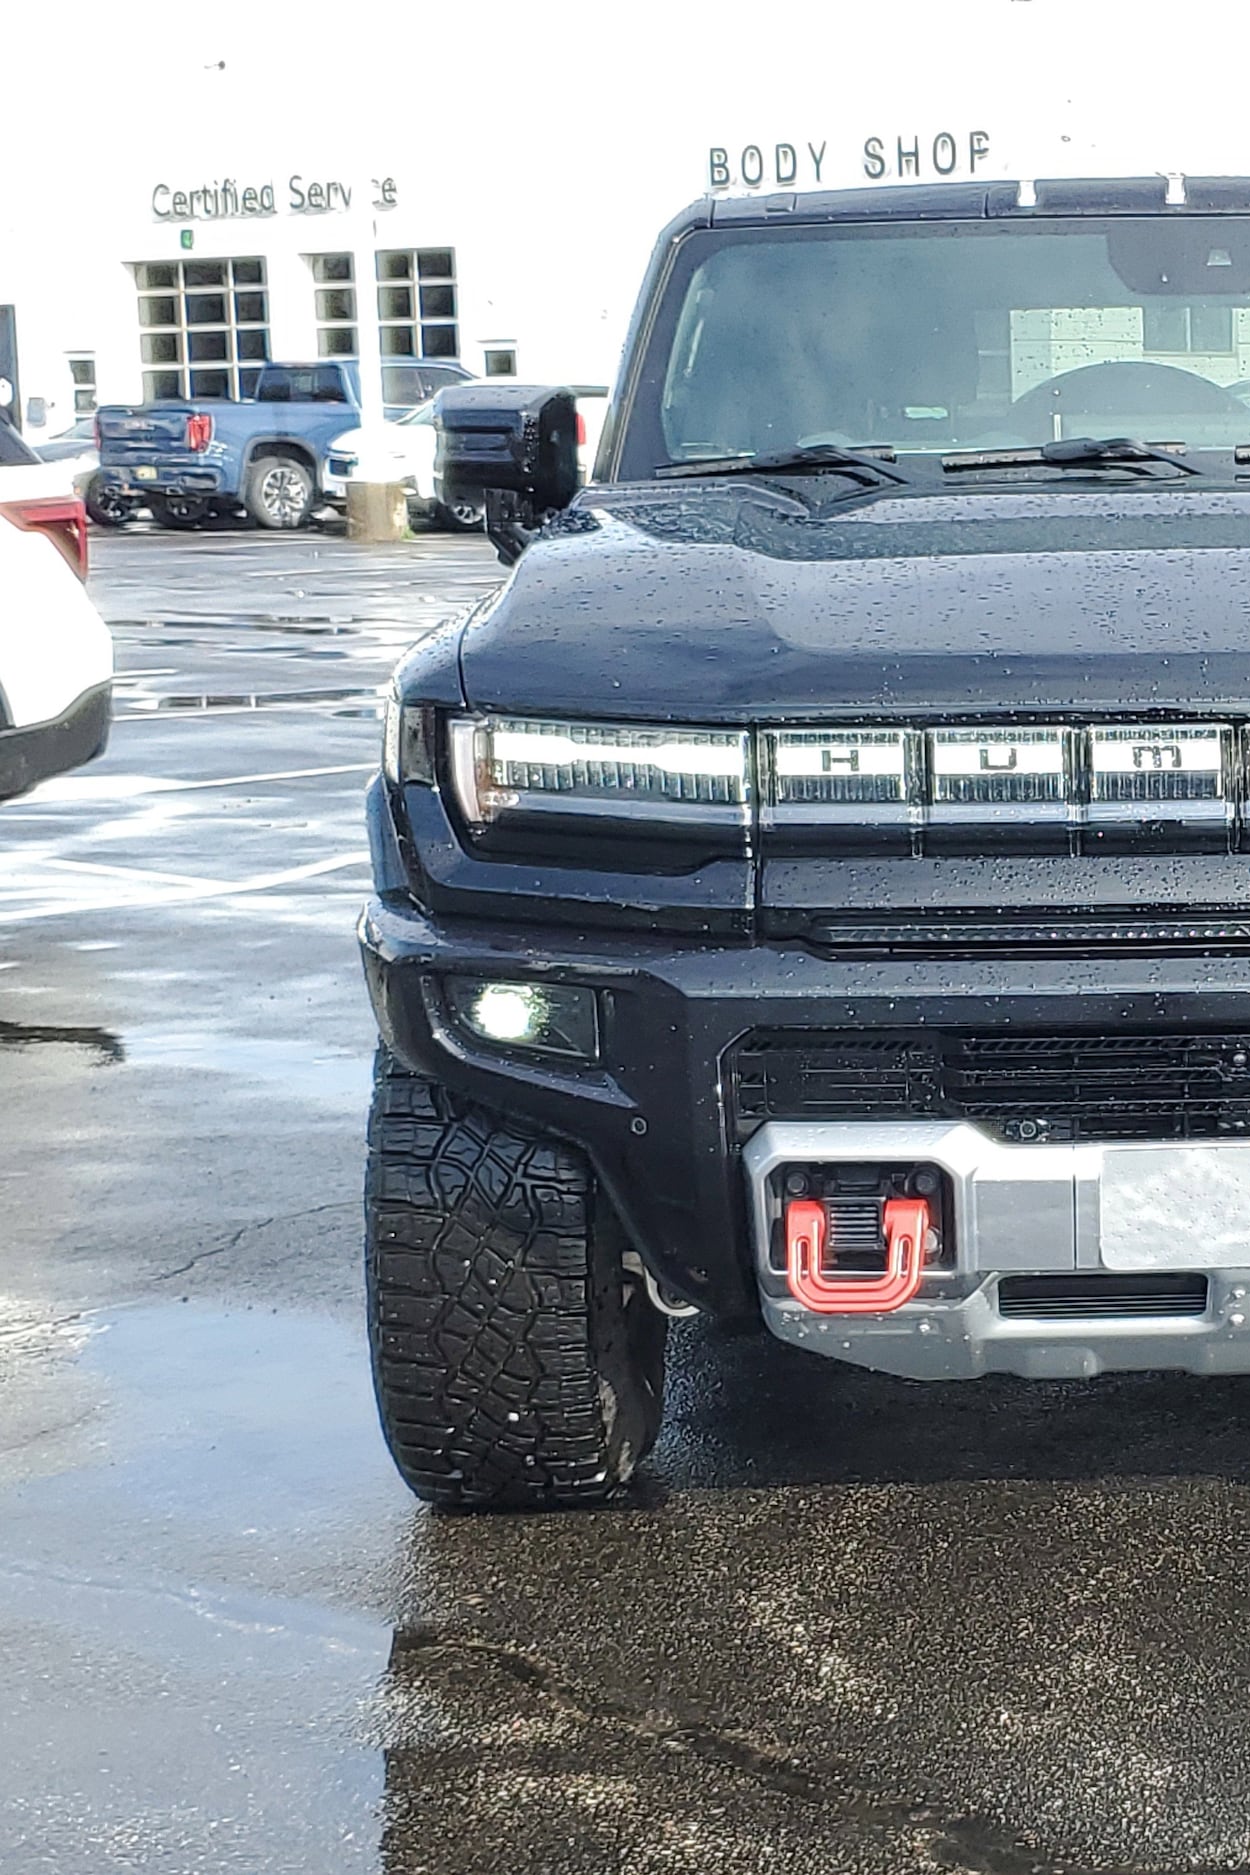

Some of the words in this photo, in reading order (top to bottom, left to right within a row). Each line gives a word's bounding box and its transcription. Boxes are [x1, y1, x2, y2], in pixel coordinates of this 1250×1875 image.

[709, 140, 827, 186] BODY
[863, 130, 990, 179] SHOP
[152, 178, 277, 217] Certified
[288, 174, 398, 211] Serve
